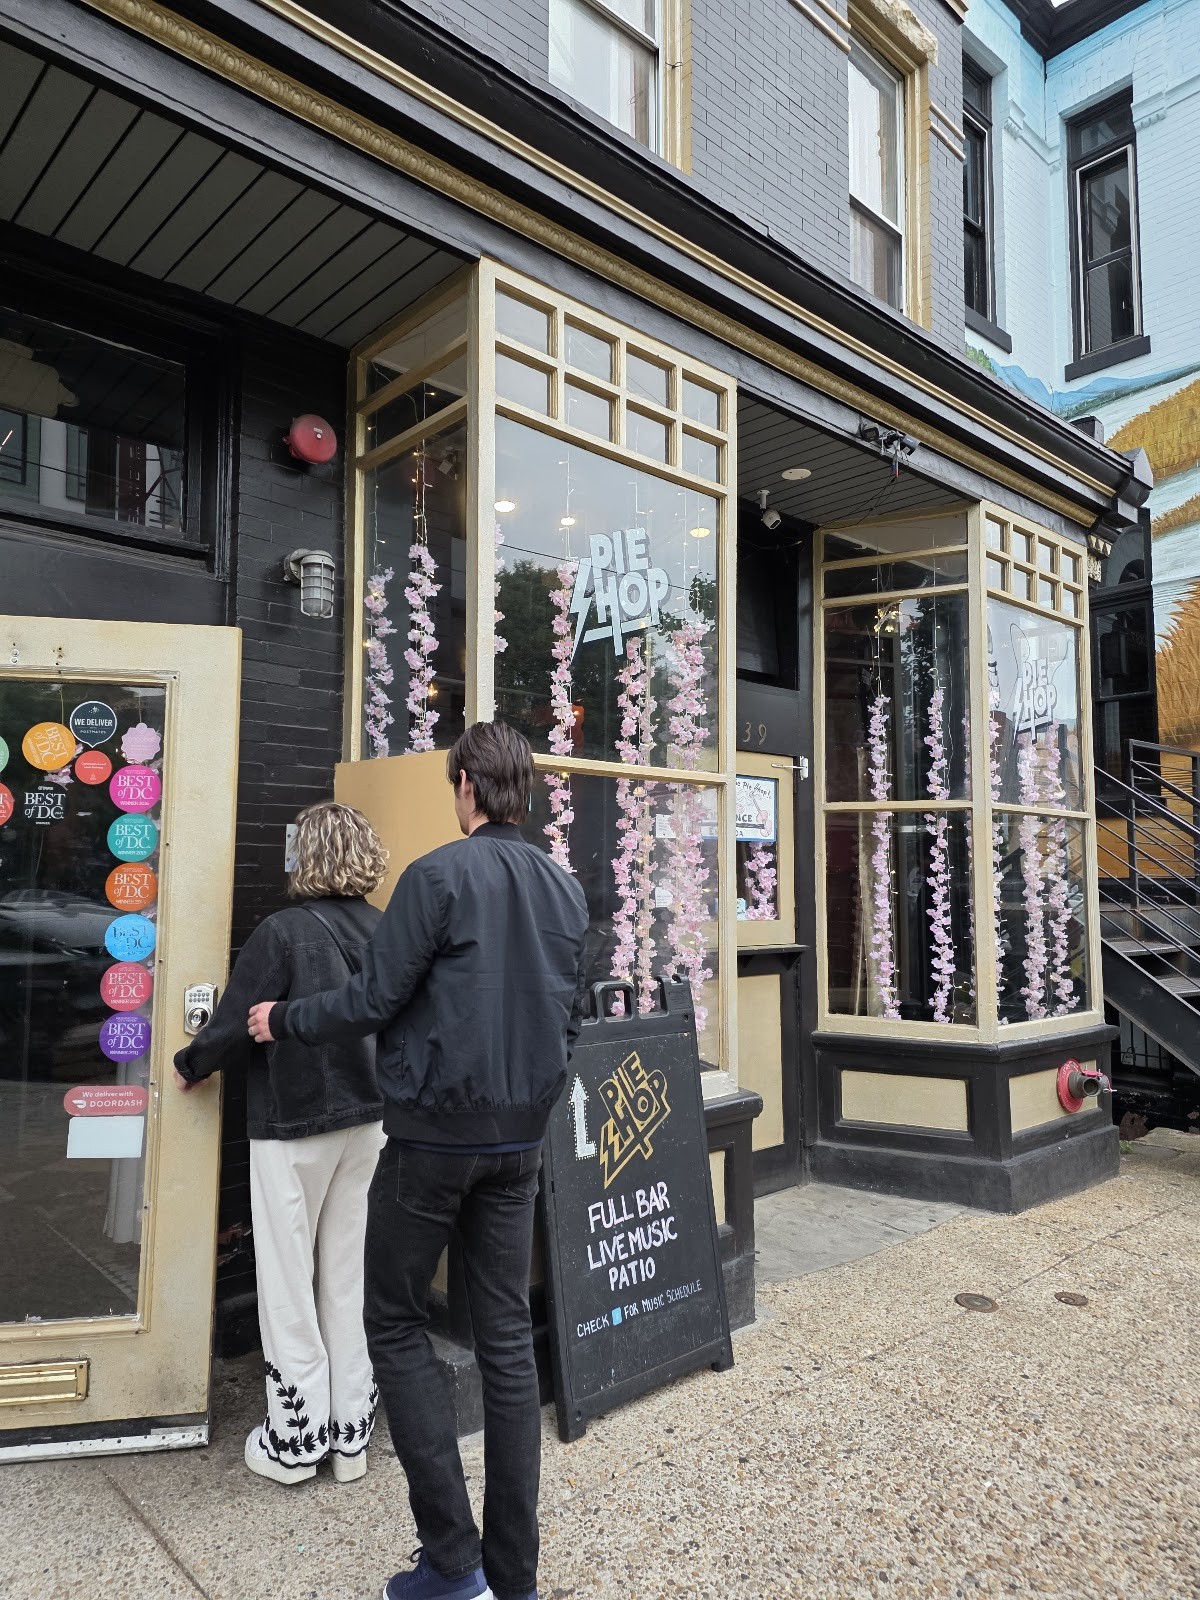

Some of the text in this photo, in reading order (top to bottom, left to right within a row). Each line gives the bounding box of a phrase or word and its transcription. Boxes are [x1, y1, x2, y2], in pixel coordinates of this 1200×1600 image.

[589, 527, 650, 578] PIE
[1022, 658, 1048, 691] PIE
[74, 718, 113, 727] WE DELIVER
[45, 726, 69, 758] BEST
[117, 775, 155, 788] BEST
[24, 792, 66, 806] BEST
[117, 787, 129, 798] of
[24, 805, 37, 818] of
[115, 824, 152, 836] BEST
[115, 836, 126, 848] of
[114, 873, 152, 886] BEST
[113, 885, 125, 898] of
[108, 972, 146, 985] BEST
[108, 985, 120, 997] of
[107, 1022, 146, 1036] BEST
[107, 1035, 120, 1048] of
[598, 1051, 648, 1119] PIE
[89, 1099, 143, 1108] DOORDASH
[588, 1181, 671, 1234] FULL BAR
[586, 1216, 678, 1271] LIVE MUSIC
[608, 1256, 656, 1292] PATIO
[576, 1279, 703, 1338] CHECK FOR MUSIC SCHEDULE
